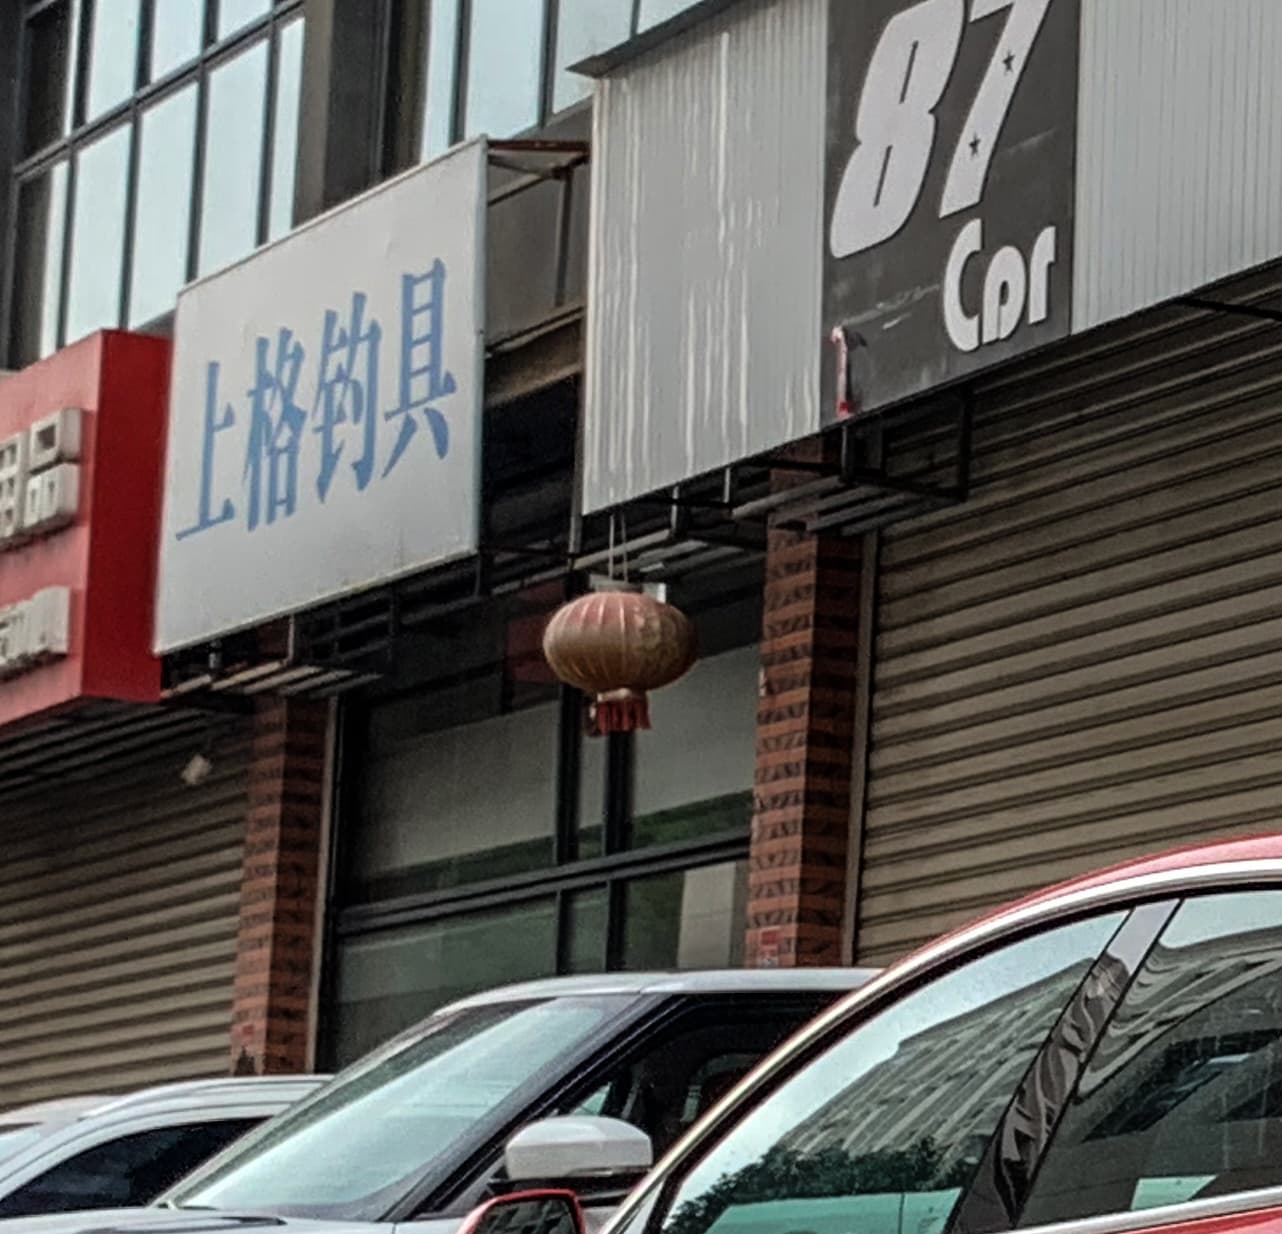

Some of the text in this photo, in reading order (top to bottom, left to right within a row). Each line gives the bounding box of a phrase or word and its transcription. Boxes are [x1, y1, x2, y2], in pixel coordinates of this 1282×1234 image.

[830, 0, 1050, 259] 87
[175, 257, 457, 541] 上格钓具
